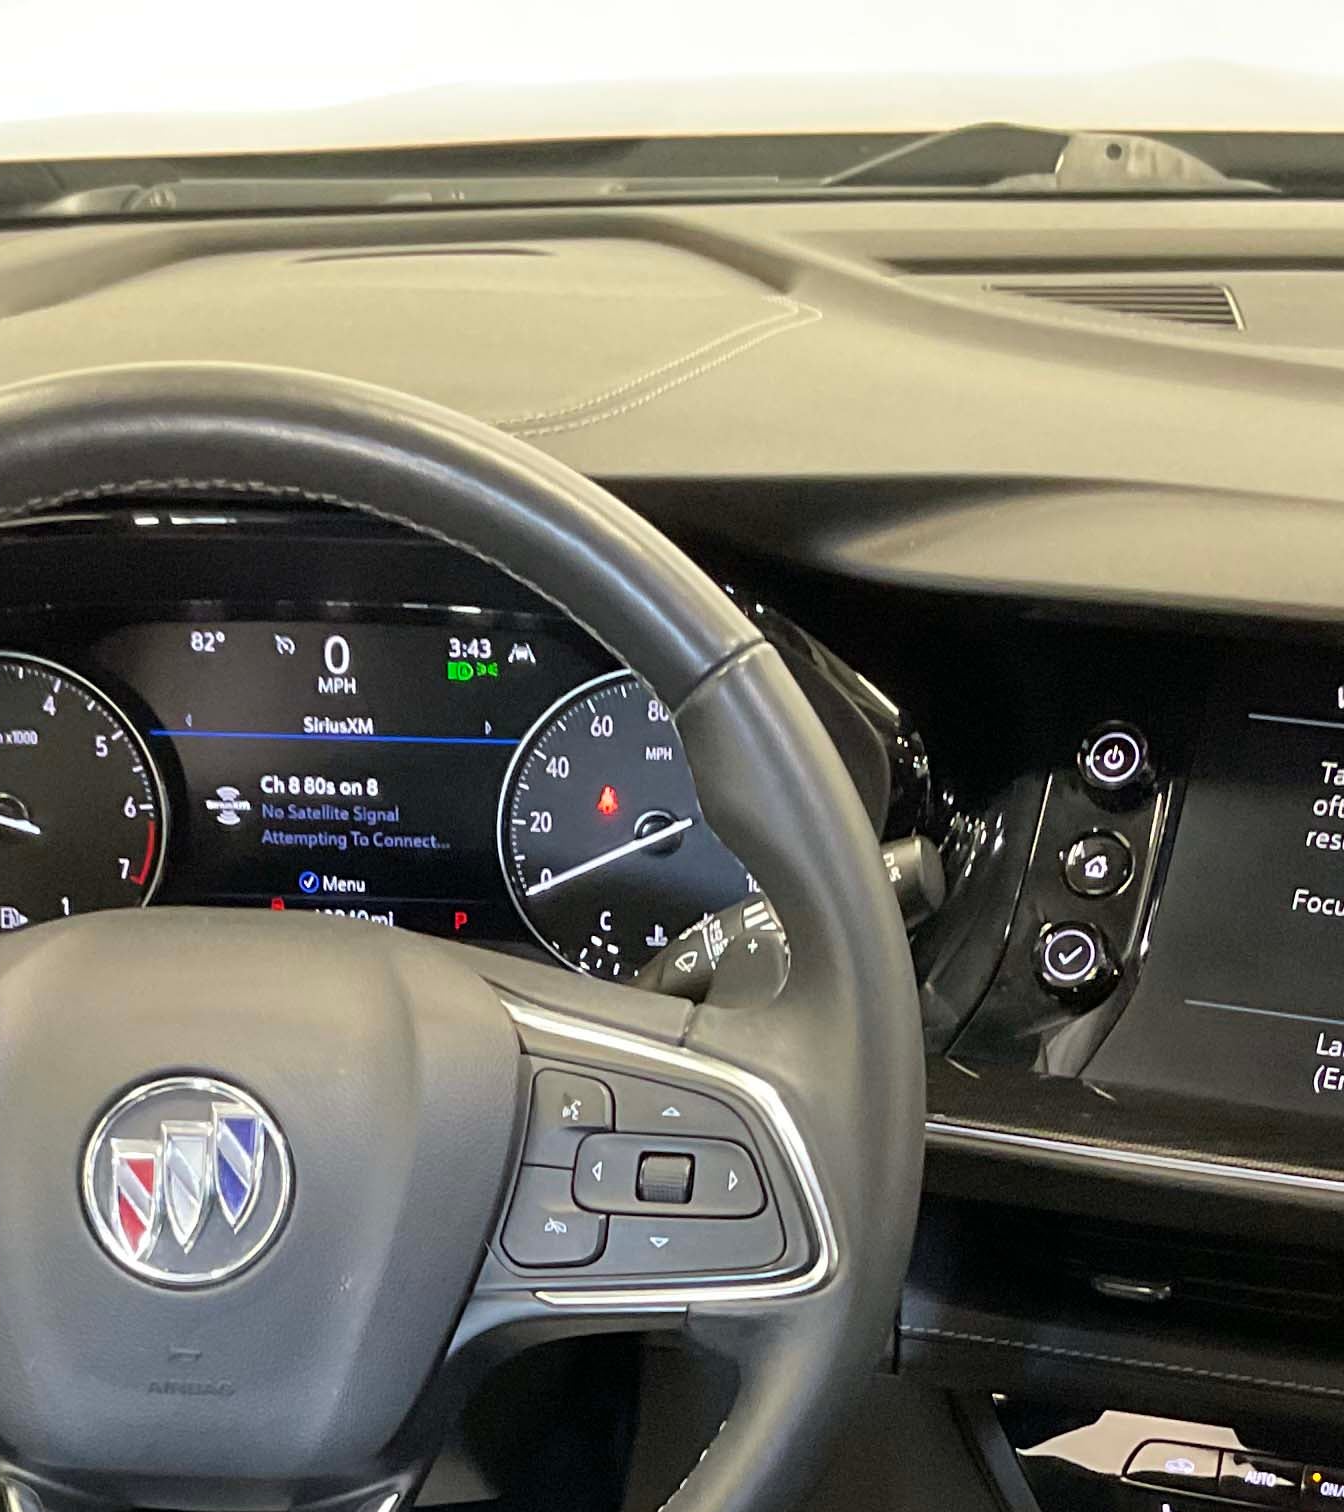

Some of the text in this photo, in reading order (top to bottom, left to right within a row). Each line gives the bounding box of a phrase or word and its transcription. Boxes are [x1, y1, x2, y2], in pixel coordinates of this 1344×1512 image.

[324, 635, 350, 675] 0
[448, 637, 492, 660] 3:43
[318, 677, 356, 695] MPH
[42, 695, 57, 717] 4
[303, 716, 373, 735] SiriusXM
[590, 715, 614, 738] 60
[95, 736, 108, 757] 5
[645, 747, 672, 761] MPH
[546, 756, 570, 779] 40
[260, 775, 379, 797] Ch 8 80s on 8
[123, 796, 137, 818] 6
[261, 804, 284, 821] No
[287, 804, 349, 822] Satellite
[353, 805, 400, 826] Signal
[530, 811, 552, 832] 20
[261, 830, 347, 850] Attempting
[351, 832, 369, 847] To
[119, 858, 129, 880] 7
[322, 874, 366, 893] Menu
[455, 911, 468, 929] P
[600, 912, 611, 931] C
[1244, 1471, 1276, 1487] AUTO
